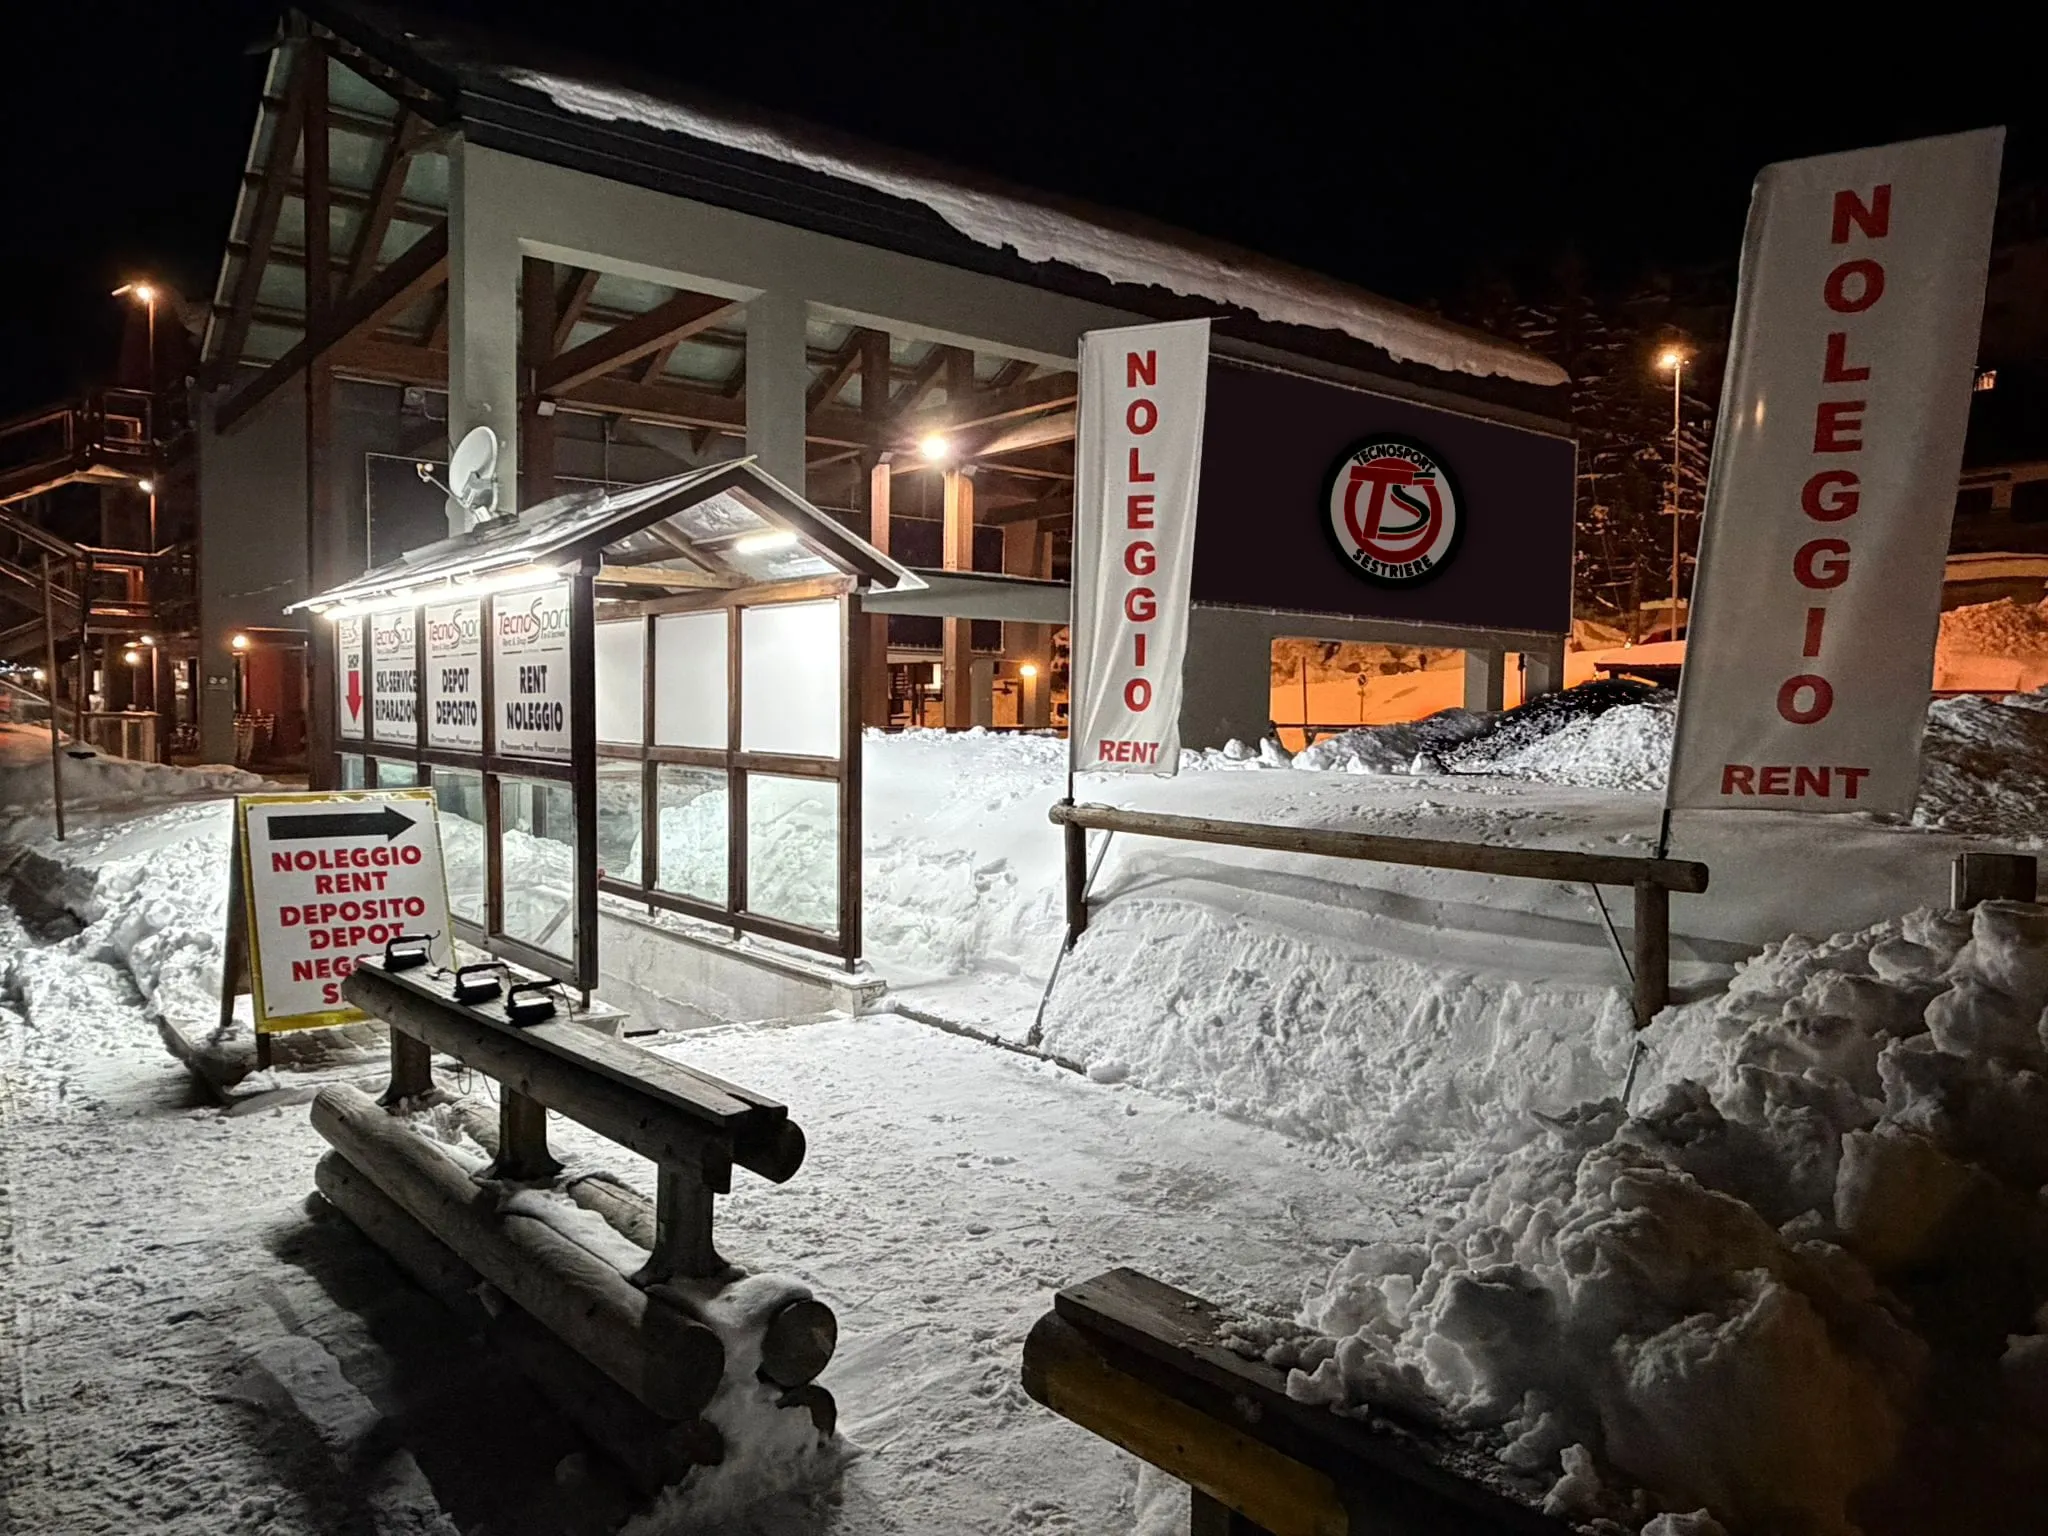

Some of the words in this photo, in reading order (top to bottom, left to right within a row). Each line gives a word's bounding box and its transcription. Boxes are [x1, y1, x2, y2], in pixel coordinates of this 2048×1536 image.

[1353, 445, 1435, 473] TECNOSPORT
[1777, 184, 1891, 725] NOLEGGIO
[1124, 351, 1158, 712] NOLEGGIO
[1353, 549, 1433, 577] SESTRIERE
[442, 668, 469, 693] DEPOT
[519, 665, 547, 694] RENT
[375, 699, 417, 723] RIPARAZION
[436, 700, 477, 726] DEPOSITO
[506, 702, 563, 732] NOLEGGIO
[1099, 739, 1159, 764] RENT
[1720, 764, 1870, 799] RENT
[271, 845, 422, 873] NOLEGGIO
[315, 871, 388, 895] RENT
[279, 896, 425, 927] DEPOSITO
[309, 922, 405, 950] DEPOT
